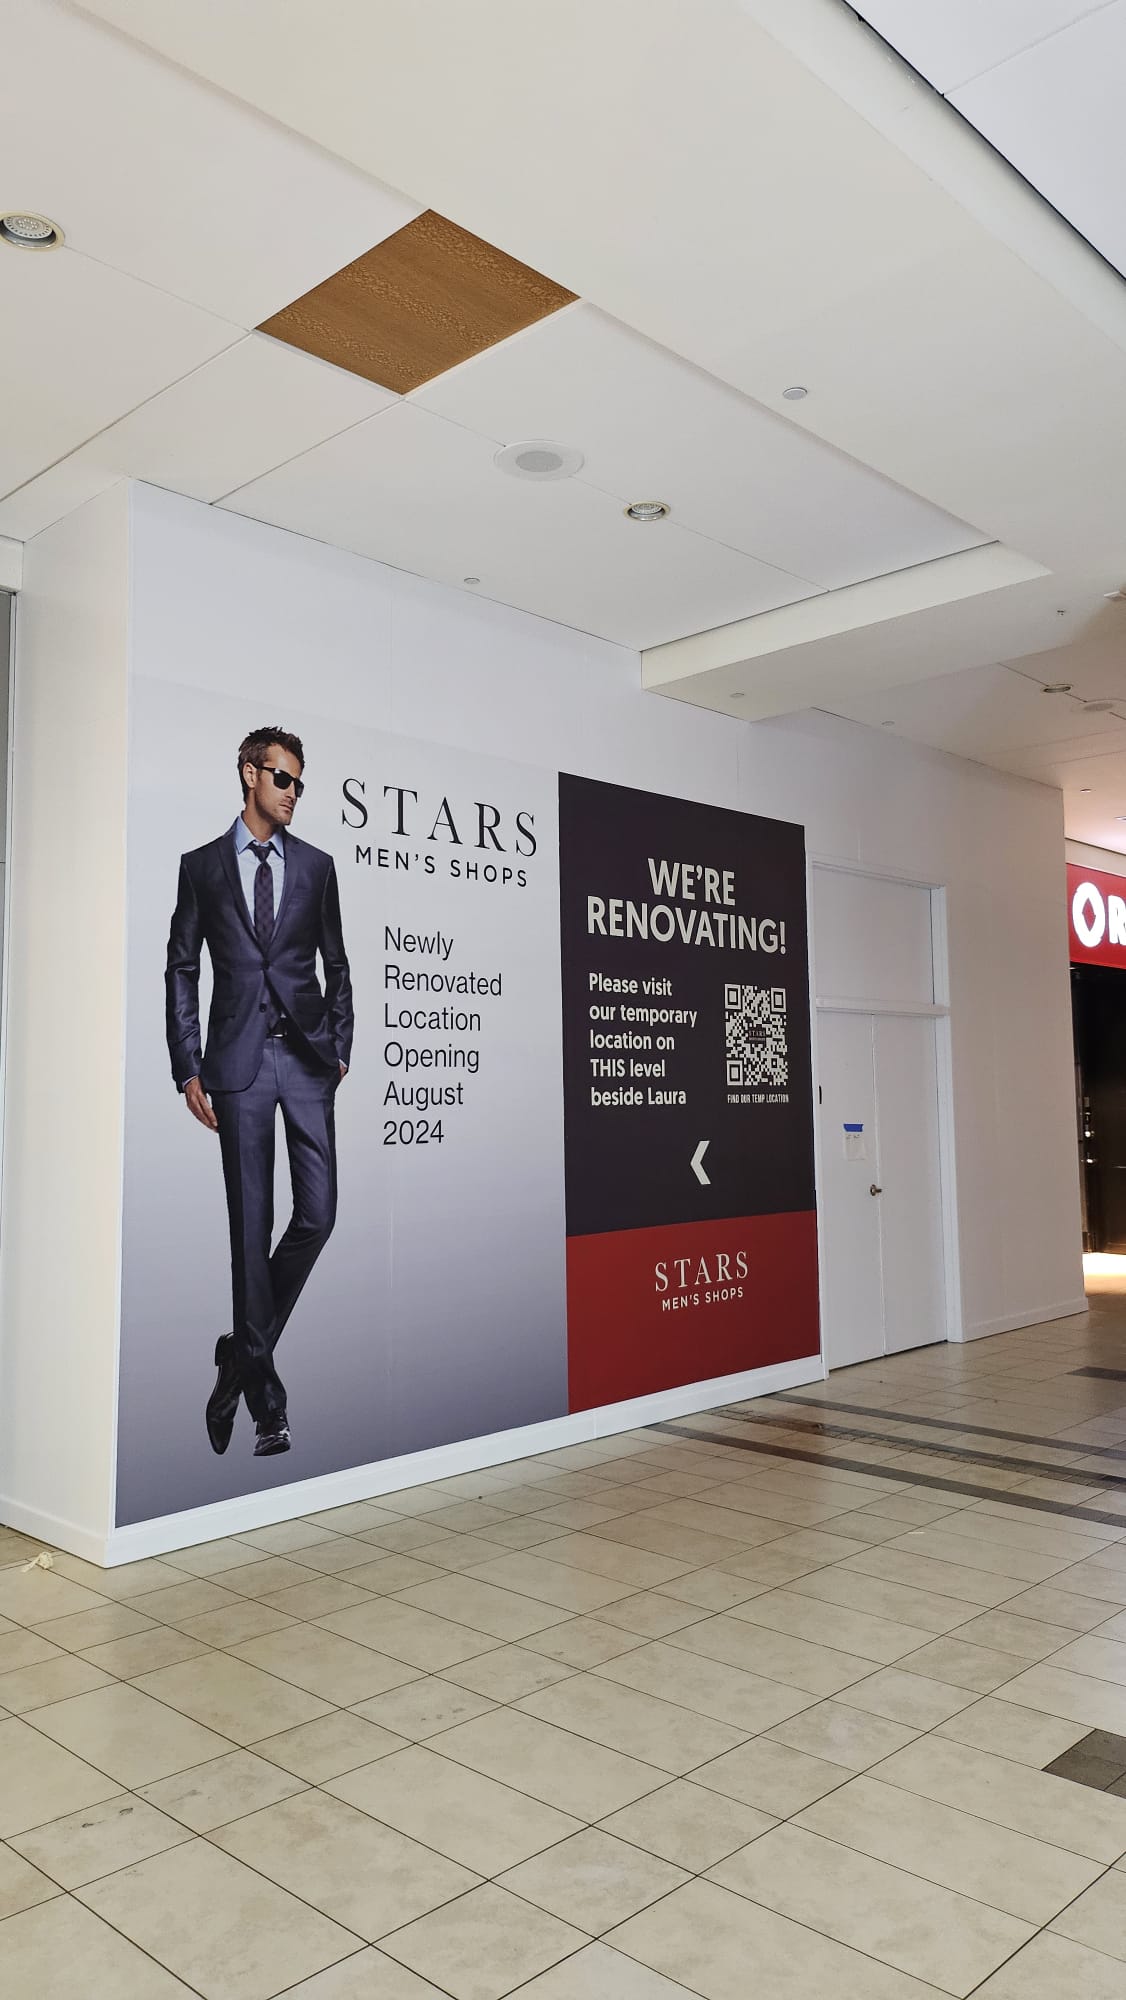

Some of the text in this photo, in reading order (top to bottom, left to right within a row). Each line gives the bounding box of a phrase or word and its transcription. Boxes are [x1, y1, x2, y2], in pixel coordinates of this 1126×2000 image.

[341, 778, 537, 857] STARS
[355, 845, 527, 887] MEN'S SHOPS
[648, 857, 736, 906] WE'RE
[587, 895, 786, 955] RENOVATING!
[384, 926, 454, 961] Newly
[384, 965, 502, 996] Renovated
[589, 972, 672, 996] Please visit
[384, 1002, 481, 1032] Location
[589, 1004, 698, 1028] our temporary
[590, 1029, 675, 1050] location on
[383, 1041, 480, 1073] Opening
[590, 1058, 666, 1078] THIS level
[383, 1081, 464, 1111] August
[591, 1086, 687, 1106] beside Laura
[751, 1094, 765, 1104] TEMP
[383, 1119, 445, 1146] 2024
[655, 1251, 748, 1292] STARS
[662, 1286, 744, 1312] MEN'S SHOPS
